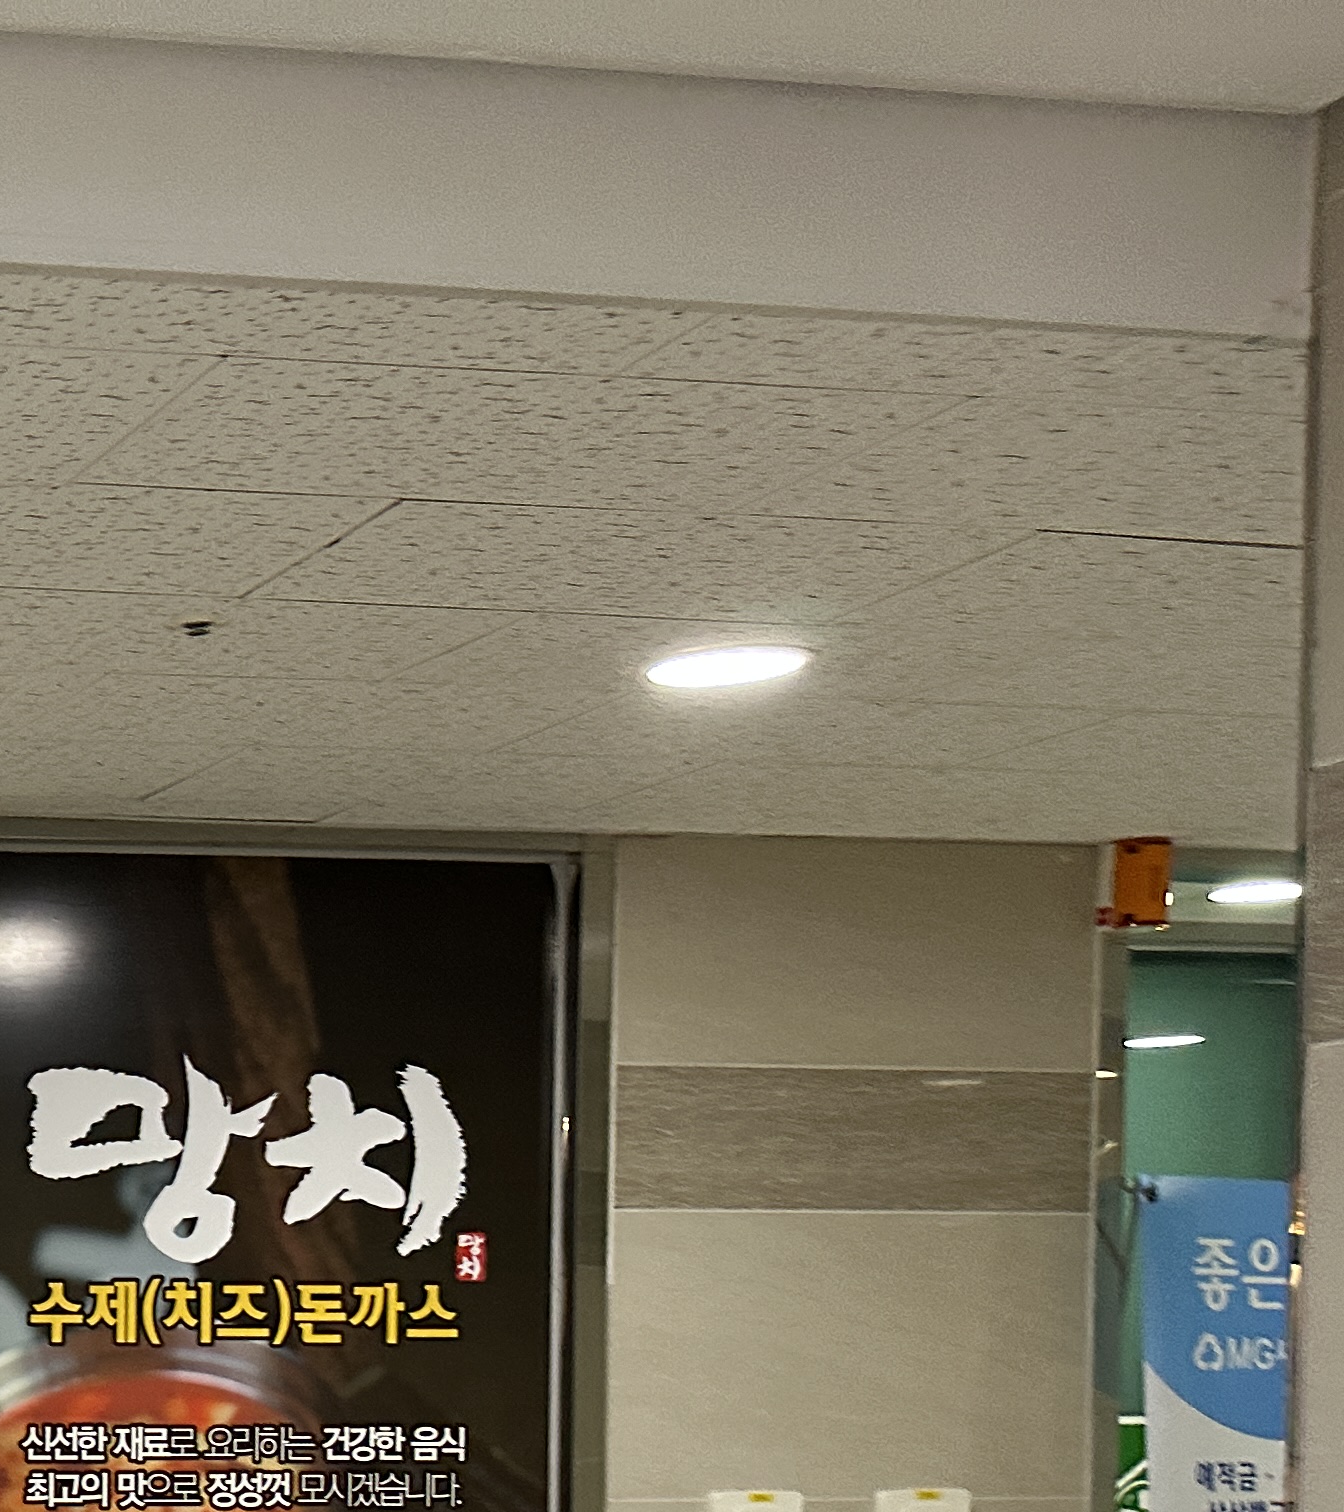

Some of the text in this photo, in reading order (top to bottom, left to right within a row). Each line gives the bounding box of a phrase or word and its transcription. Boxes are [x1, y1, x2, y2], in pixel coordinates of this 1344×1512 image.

[27, 1053, 467, 1263] 망치
[1192, 1236, 1286, 1311] 좋은
[29, 1279, 460, 1346] 수제(치즈)돈까스
[20, 1425, 468, 1461] 신선한 재료로 요리하는 건강한 음식
[25, 1472, 463, 1507] 최고의 맛으로 정성껏 모시겠습니다.
